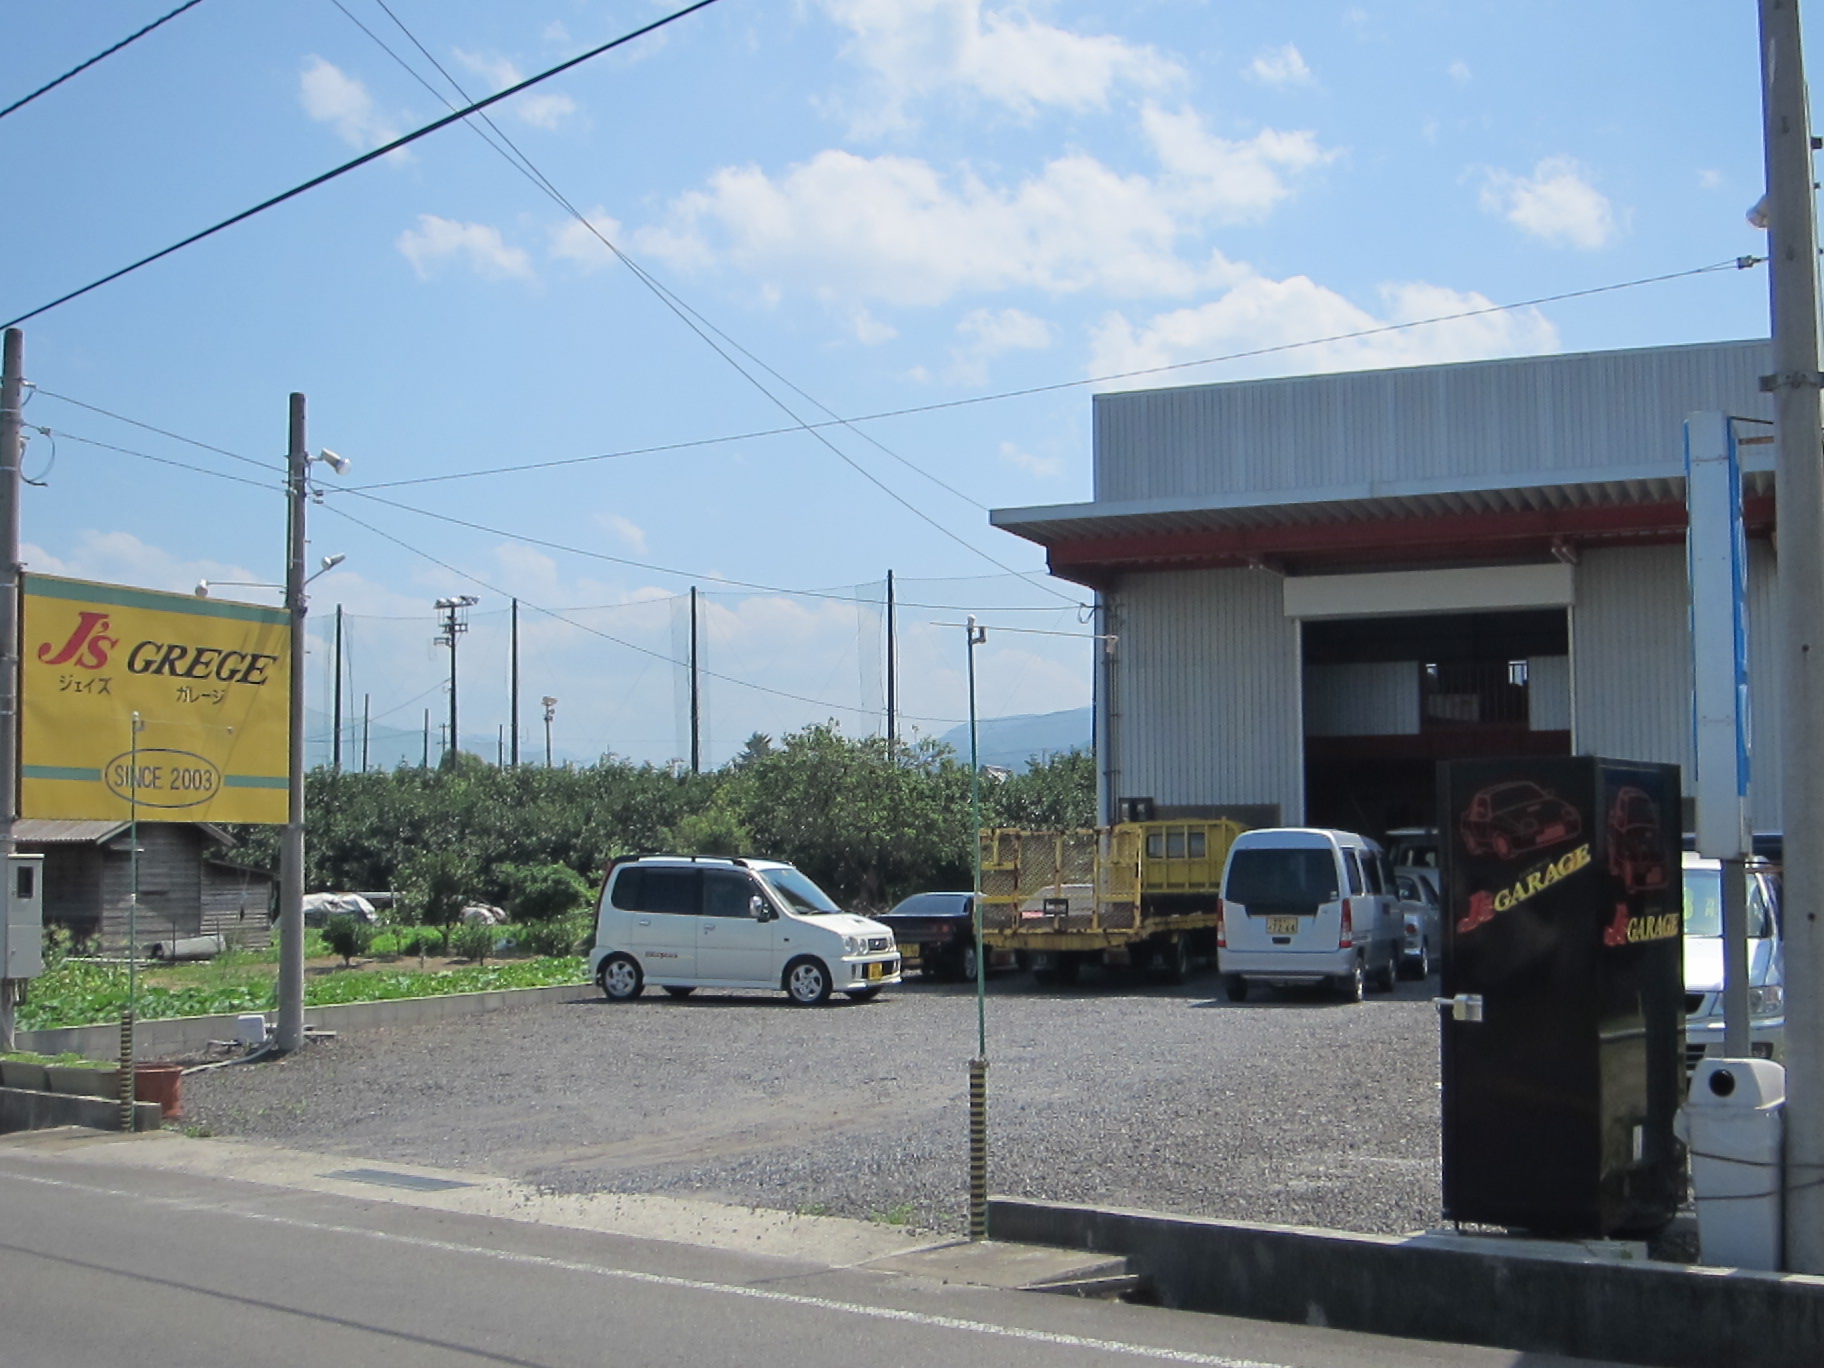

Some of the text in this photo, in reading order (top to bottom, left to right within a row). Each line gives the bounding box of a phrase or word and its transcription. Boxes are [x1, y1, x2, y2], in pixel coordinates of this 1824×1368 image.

[38, 611, 277, 685] J's GREGE
[59, 674, 226, 705] ジェイズ ガレージ
[114, 764, 213, 791] SINCE 2003
[1493, 843, 1591, 912] GARAGE
[1627, 913, 1680, 943] GARAGE
